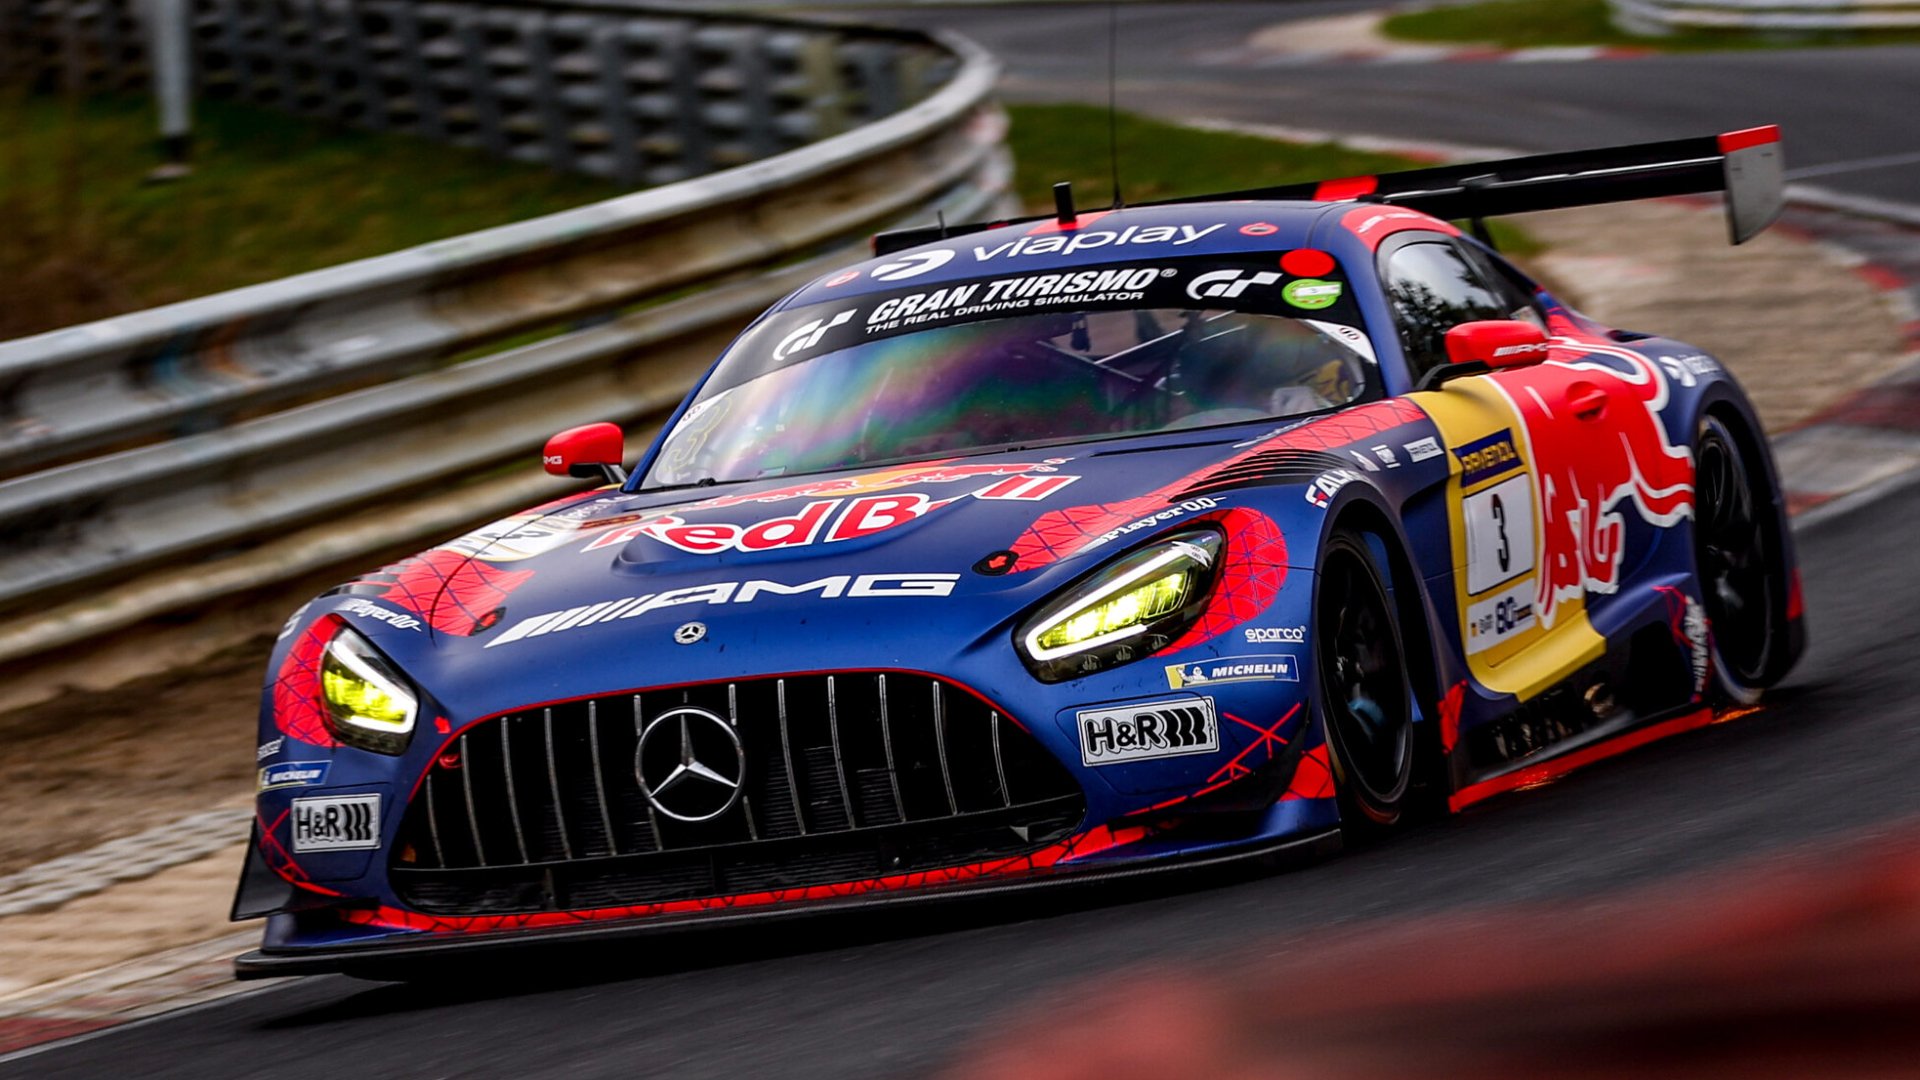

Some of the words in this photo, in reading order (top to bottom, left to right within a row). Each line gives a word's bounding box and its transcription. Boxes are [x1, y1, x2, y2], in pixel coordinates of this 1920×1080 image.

[973, 222, 1227, 261] viaplay
[865, 319, 900, 335] THE
[904, 306, 950, 325] REAL
[954, 298, 1031, 317] DRIVING
[1034, 291, 1144, 306] SIMULATOR
[867, 283, 981, 325] GRAN
[1490, 493, 1510, 573] 3
[1245, 626, 1304, 643] sparco
[1212, 664, 1289, 678] MICHELIN
